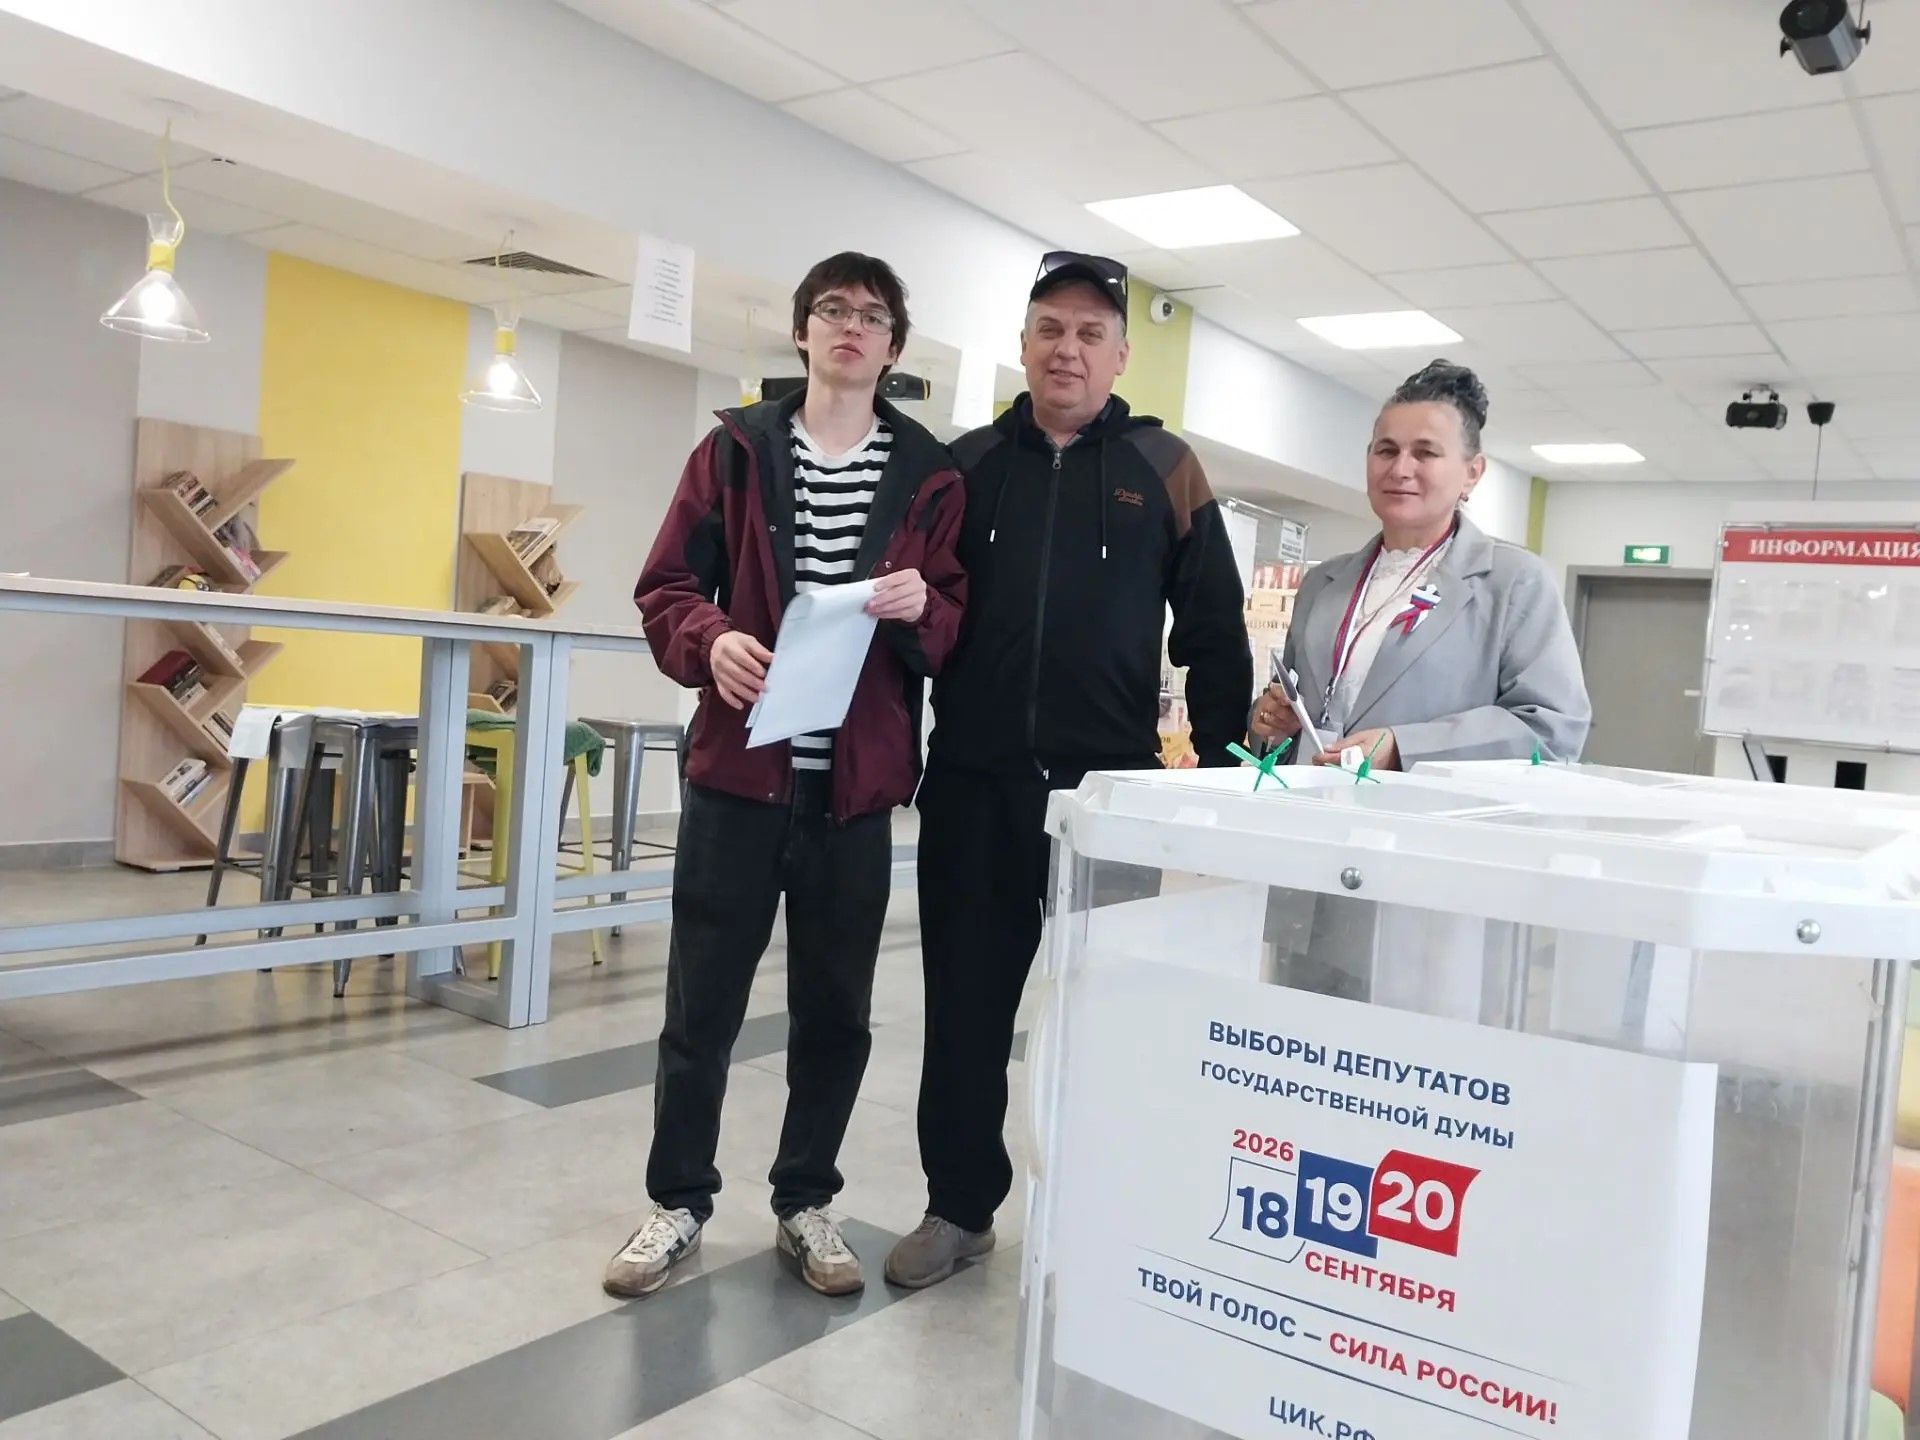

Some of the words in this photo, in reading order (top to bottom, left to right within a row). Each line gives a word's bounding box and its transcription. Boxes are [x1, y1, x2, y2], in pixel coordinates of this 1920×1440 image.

[1749, 538, 1920, 560] ИНФОРМАЦИЯ
[1209, 1020, 1326, 1067] ВЫБОРЫ
[1333, 1049, 1511, 1106] ДЕПУТАТОВ
[1201, 1059, 1429, 1130] ГОСУДАРСТВЕННОЙ
[1434, 1115, 1514, 1150] ДУМЫ
[1232, 1128, 1294, 1162] 2026
[1236, 1185, 1290, 1239] 18
[1305, 1176, 1363, 1232] 19
[1376, 1170, 1456, 1231] 20
[1304, 1251, 1456, 1313] СЕНТЯБРЯ
[1137, 1267, 1203, 1307] ТВОЙ
[1209, 1291, 1297, 1338] ГОЛОС
[1329, 1332, 1408, 1376] СИЛА
[1416, 1359, 1557, 1425] РОССИИ!
